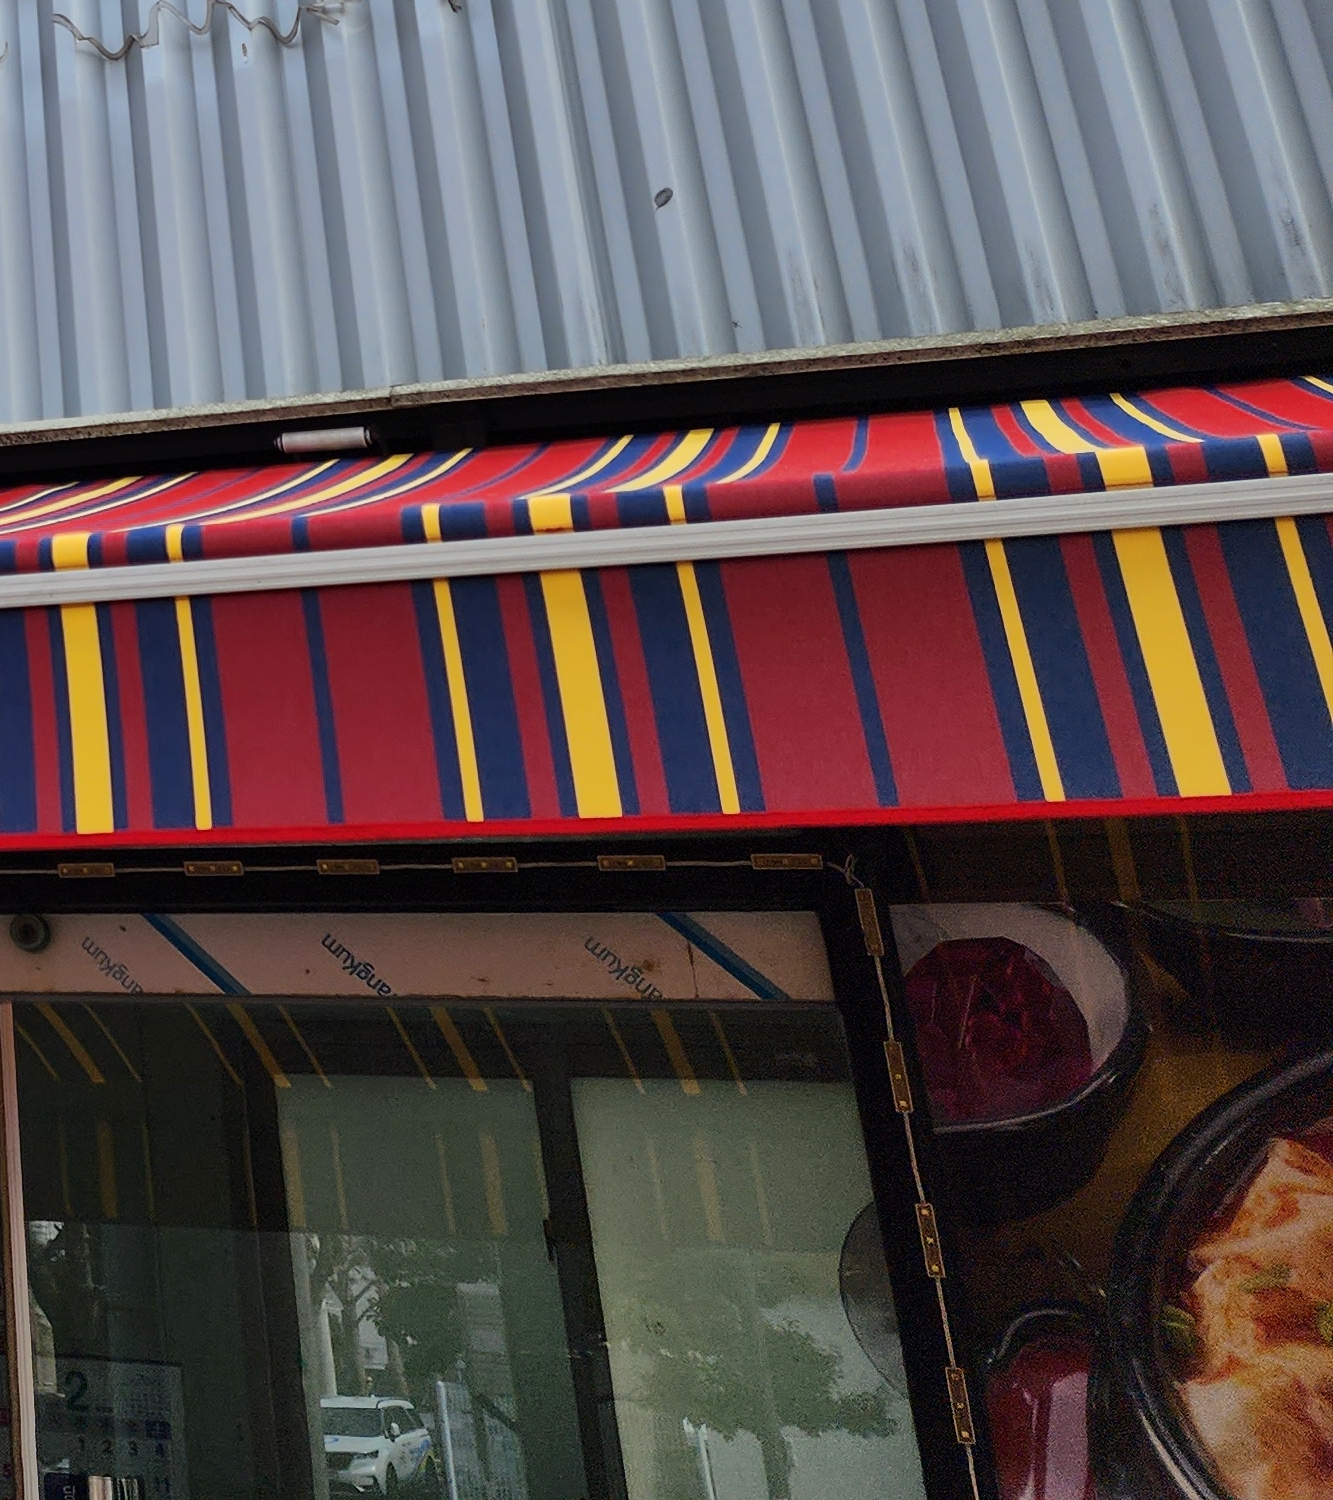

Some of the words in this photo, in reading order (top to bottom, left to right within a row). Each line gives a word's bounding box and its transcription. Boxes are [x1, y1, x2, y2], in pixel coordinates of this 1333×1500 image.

[81, 936, 144, 995] angKum
[320, 932, 392, 997] angKum
[583, 936, 664, 1000] angKum
